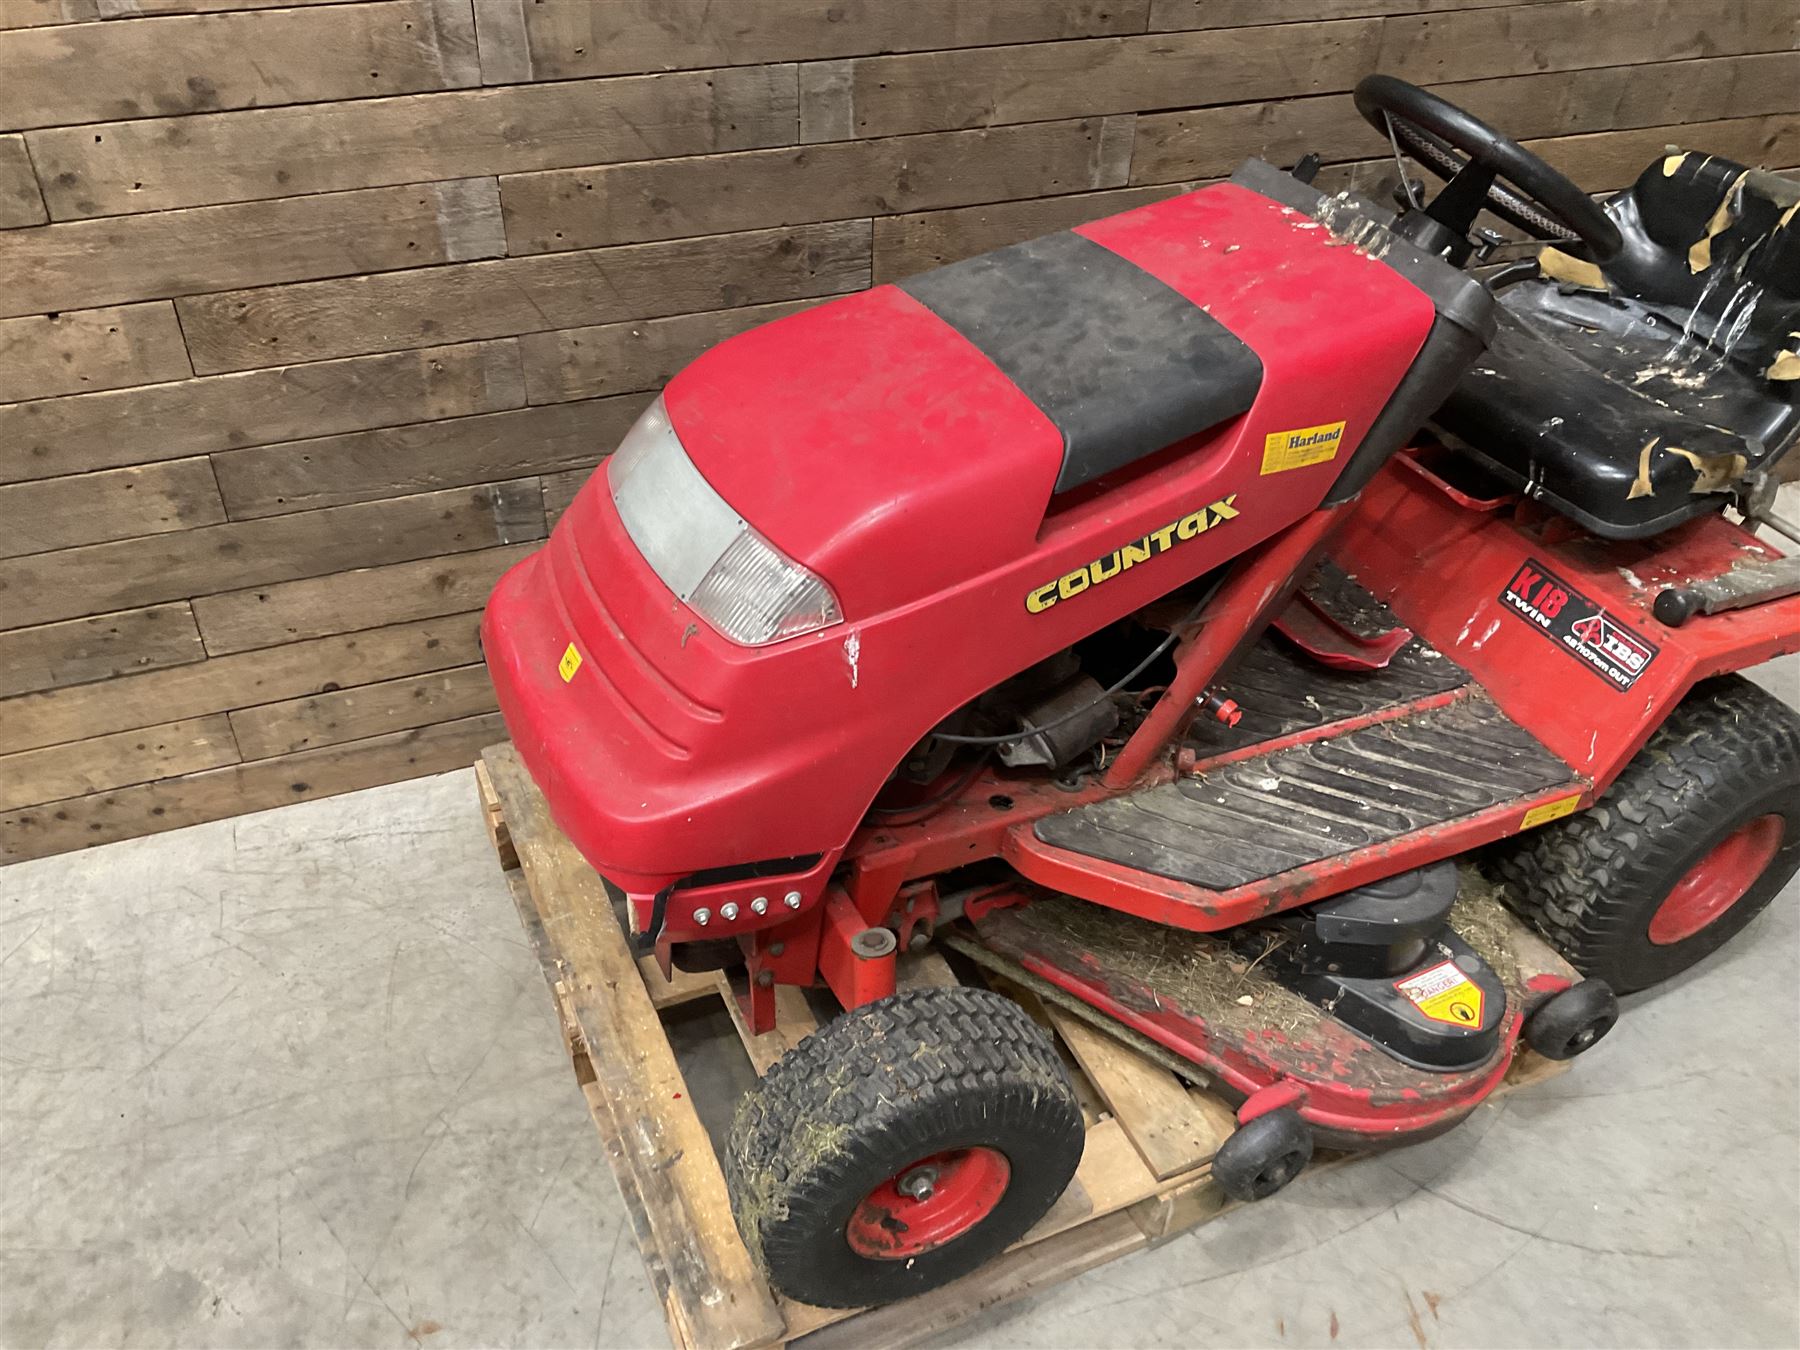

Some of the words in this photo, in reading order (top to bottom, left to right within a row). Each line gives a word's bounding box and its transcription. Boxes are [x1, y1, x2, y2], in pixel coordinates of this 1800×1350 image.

[1289, 427, 1341, 449] Harland
[1506, 590, 1552, 628] TWIN
[1603, 634, 1645, 670] IBS
